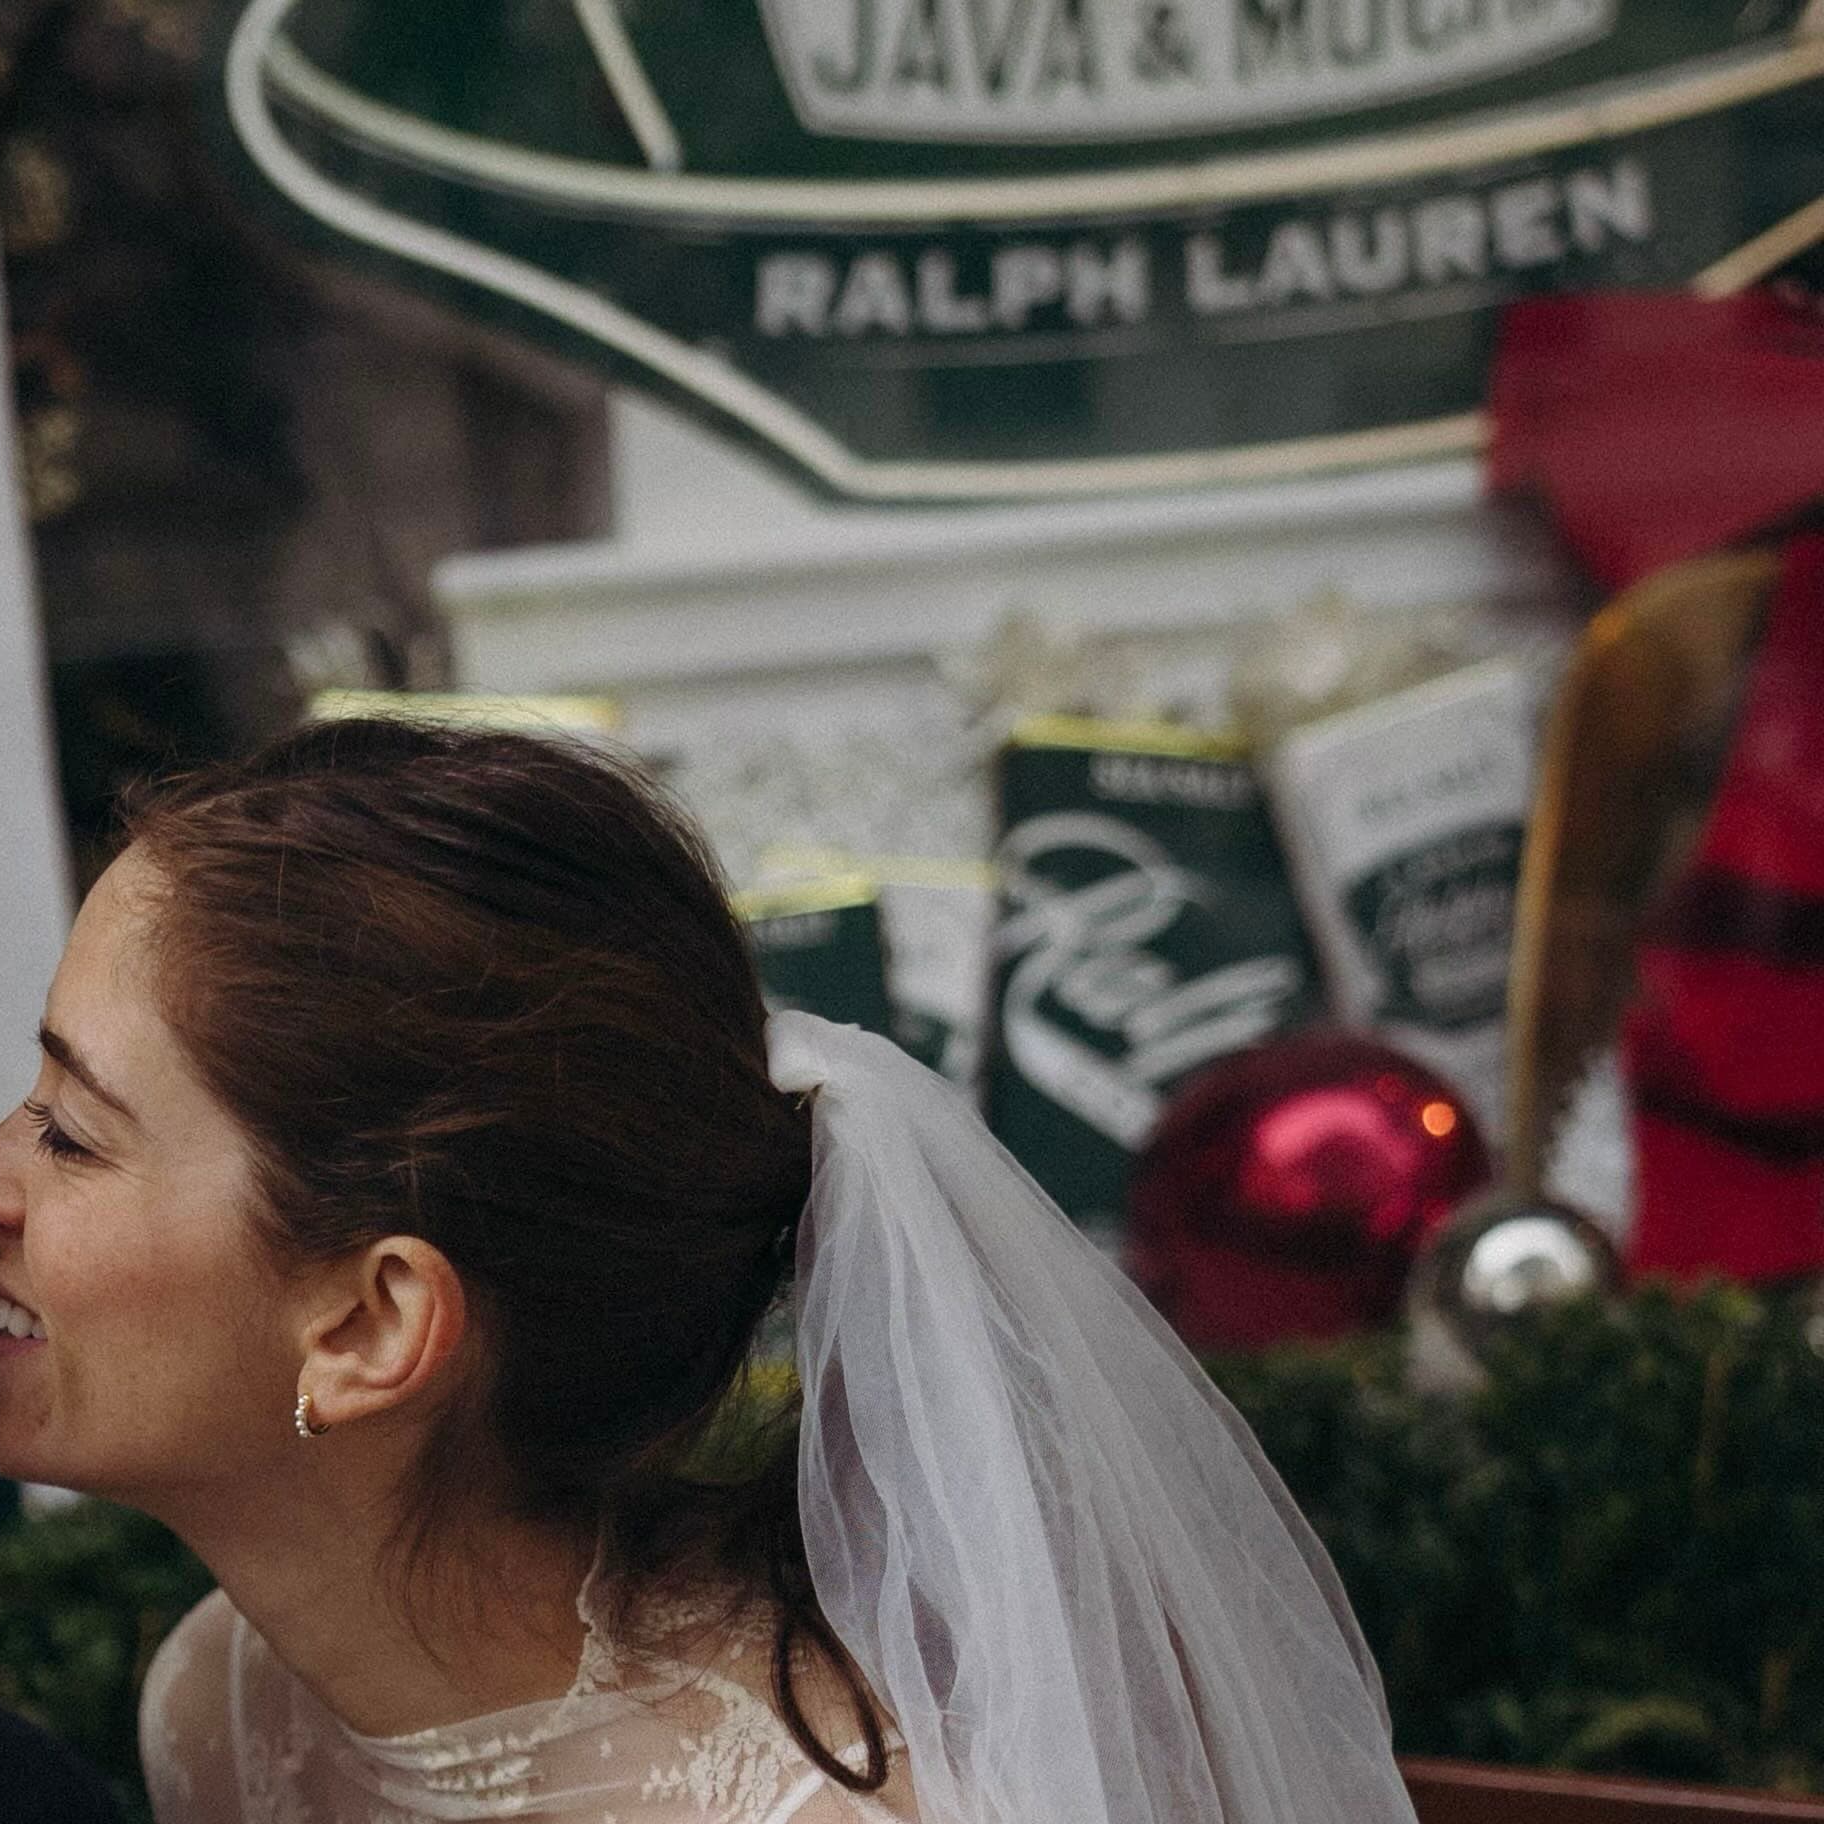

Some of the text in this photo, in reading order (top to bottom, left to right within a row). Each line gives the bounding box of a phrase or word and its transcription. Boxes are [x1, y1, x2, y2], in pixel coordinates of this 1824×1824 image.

[812, 0, 1101, 97] JAVA
[1131, 0, 1196, 84] &
[753, 158, 1651, 337] RALPH LAUREN
